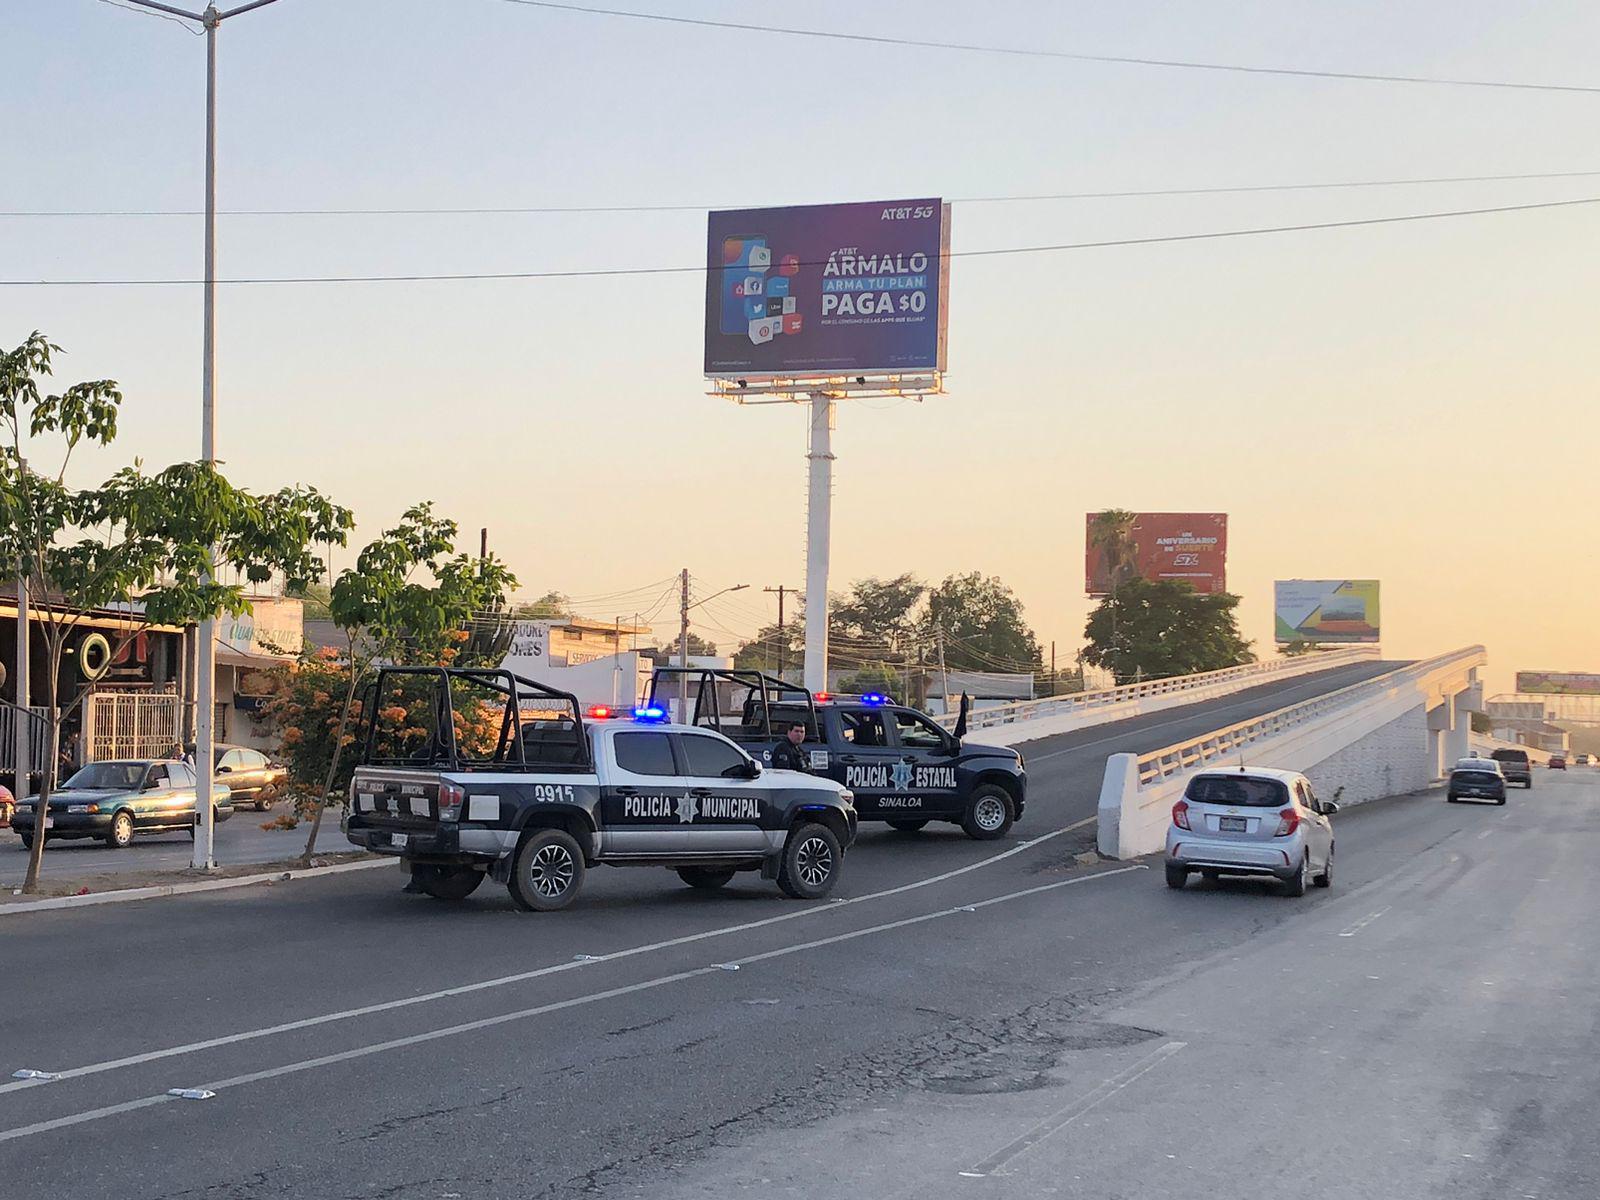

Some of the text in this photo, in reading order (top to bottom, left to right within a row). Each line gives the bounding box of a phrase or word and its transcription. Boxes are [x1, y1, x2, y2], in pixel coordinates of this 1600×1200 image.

[881, 206, 933, 220] AT&T 5G
[838, 247, 858, 256] AT&T
[823, 251, 928, 276] ÁRMALO
[826, 277, 923, 292] ARMA TU PLAN
[822, 290, 926, 316] PAGA $0
[1156, 537, 1217, 545] ANIVERSARIO
[230, 624, 297, 644] QUAKER STATE
[846, 762, 957, 788] POLICÍA ESTATAL
[534, 784, 575, 802] 0915
[624, 793, 761, 819] POLICÍA MUNICIPAL
[878, 797, 922, 808] SINALOA
